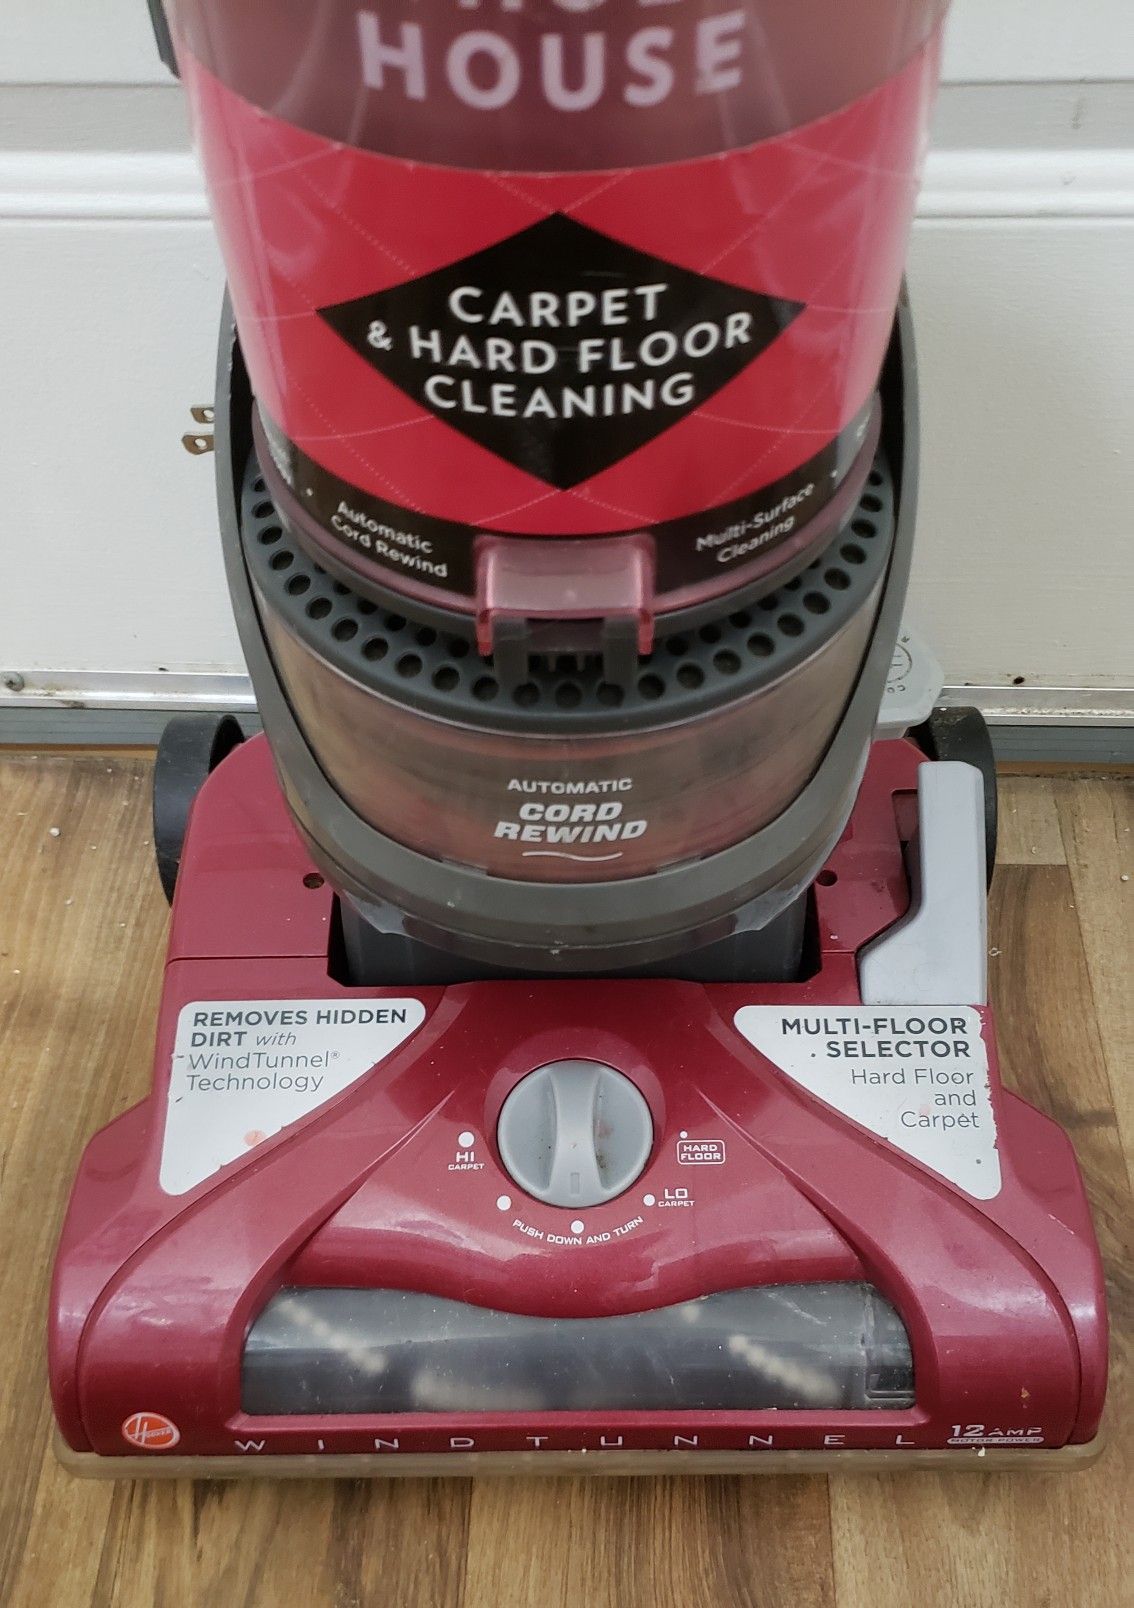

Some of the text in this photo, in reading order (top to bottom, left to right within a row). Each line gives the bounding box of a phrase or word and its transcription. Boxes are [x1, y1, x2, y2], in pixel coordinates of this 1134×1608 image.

[356, 9, 747, 111] HOUSE
[448, 283, 669, 328] CARPET
[366, 311, 753, 375] & HARD FLOOR
[423, 371, 696, 419] CLEANING
[695, 482, 815, 552] Multi-Surface
[337, 500, 433, 554] Automatic
[330, 514, 448, 578] Cord Rewind
[716, 515, 795, 563] Cleaning
[507, 777, 633, 795] AUTOMATIC
[519, 802, 624, 823] CORD
[494, 820, 648, 844] REWIND
[192, 1008, 408, 1027] REMOVES HIDDEN
[782, 1017, 968, 1036] MULTI-FLOOR
[190, 1031, 297, 1047] DIRT with
[826, 1040, 971, 1058] SELECTOR
[186, 1073, 325, 1093] Technology
[851, 1067, 975, 1085] Hard Floor
[934, 1090, 977, 1106] and
[900, 1111, 981, 1131] Carpet
[456, 1151, 475, 1163] HI
[680, 1152, 722, 1161] FLOOR
[683, 1143, 718, 1153] HARD
[448, 1162, 485, 1171] CARPET
[664, 1188, 689, 1199] LO
[658, 1199, 695, 1208] CARPET
[512, 1215, 645, 1246] PUSH DOWN AND TURN
[951, 1424, 1042, 1437] 12 AMP
